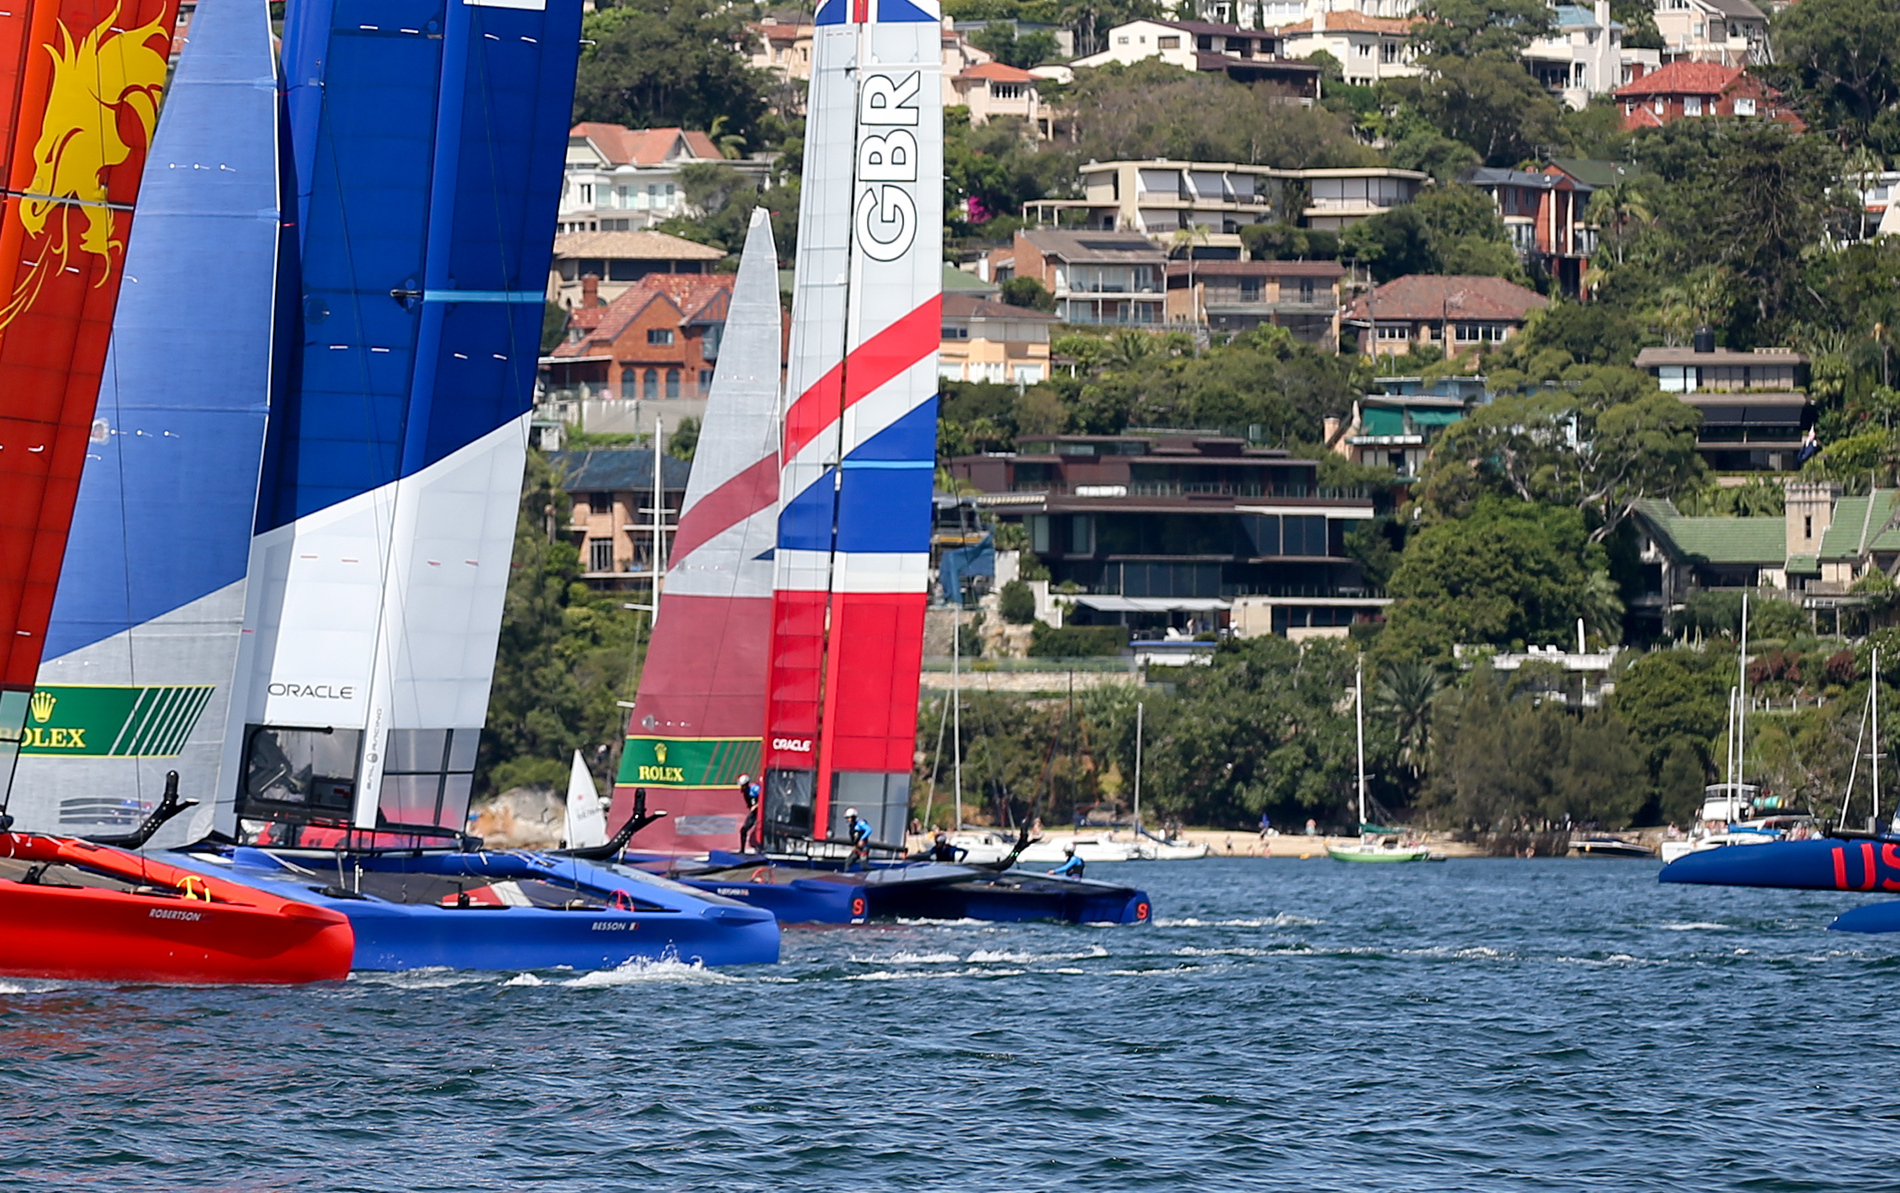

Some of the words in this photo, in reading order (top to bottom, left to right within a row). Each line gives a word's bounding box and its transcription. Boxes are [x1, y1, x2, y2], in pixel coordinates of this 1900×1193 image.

[854, 68, 921, 263] GBR
[267, 683, 354, 700] ORACLE
[772, 737, 813, 753] ORACLE
[638, 765, 684, 782] ROLEX
[148, 908, 201, 922] ROBERTSON
[851, 897, 865, 916] S
[1136, 902, 1149, 919] S
[591, 921, 627, 931] BESSON
